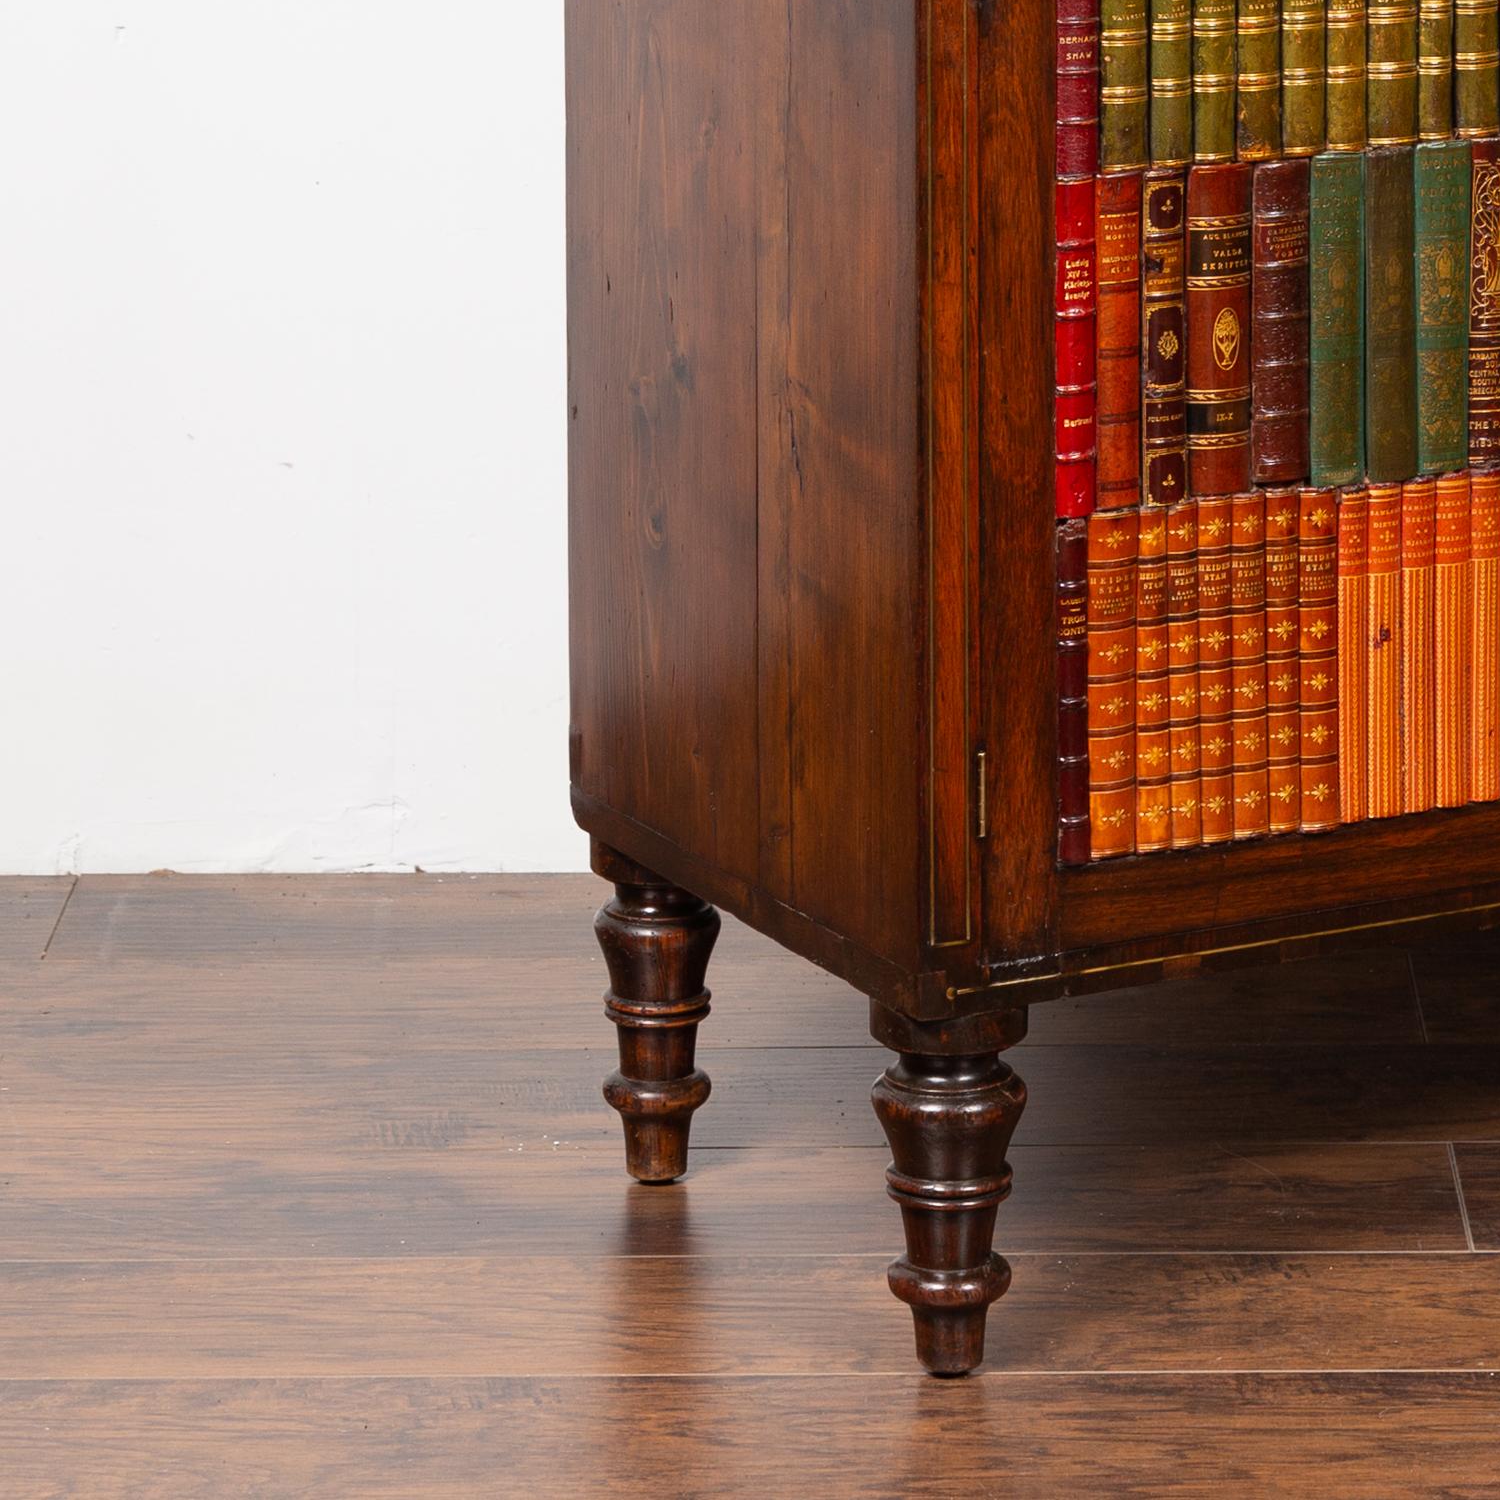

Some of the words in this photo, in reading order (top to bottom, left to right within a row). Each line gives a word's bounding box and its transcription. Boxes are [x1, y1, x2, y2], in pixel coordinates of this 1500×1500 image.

[1066, 52, 1092, 60] SHAW
[1213, 248, 1242, 257] VALDA
[1065, 259, 1089, 269] Ludvig
[1469, 370, 1500, 378] CENTRAL
[1472, 378, 1497, 386] SOUTH
[1216, 413, 1233, 421] IX-X
[1469, 421, 1489, 429] THE
[1370, 508, 1400, 516] SAMLA
[1272, 563, 1294, 572] STAM
[1305, 562, 1331, 572] STAM
[1204, 572, 1227, 581] STAM
[1238, 569, 1260, 577] STAM
[1144, 581, 1163, 590] STAM
[1175, 577, 1194, 586] STAM
[1099, 584, 1129, 594] STAM
